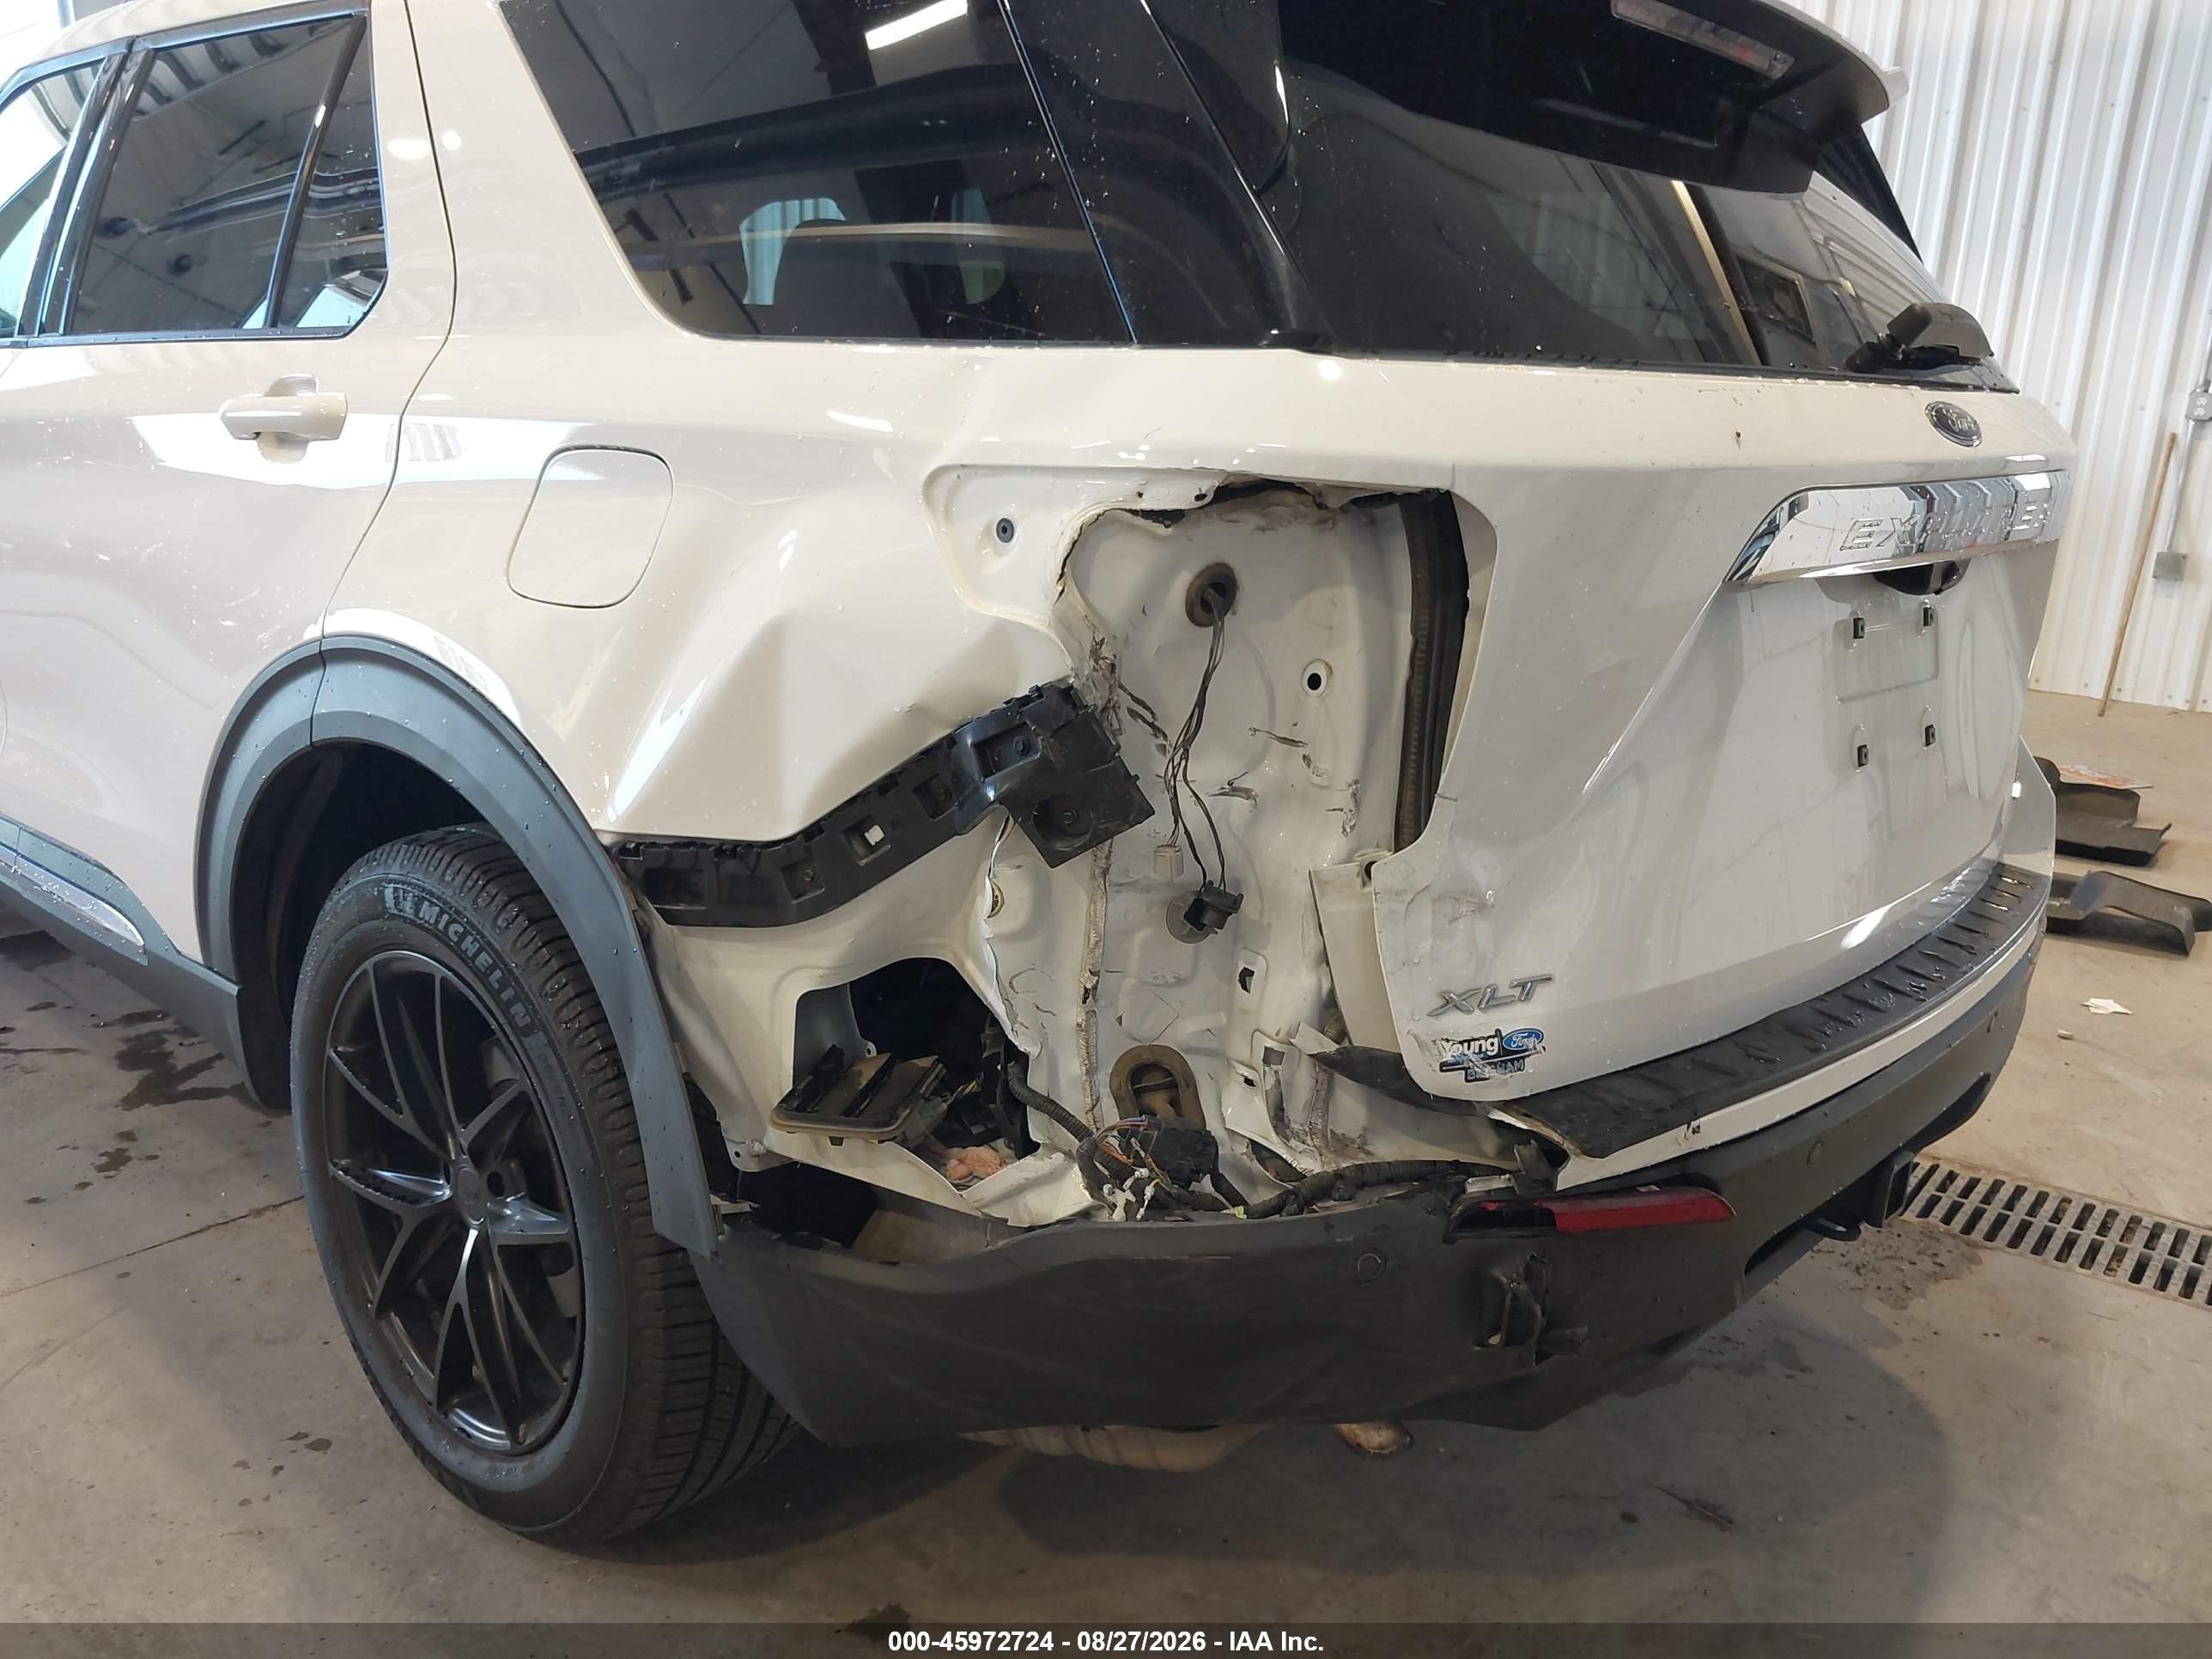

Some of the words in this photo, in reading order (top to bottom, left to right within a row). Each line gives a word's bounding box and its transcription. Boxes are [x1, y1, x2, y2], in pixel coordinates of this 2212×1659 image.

[419, 901, 531, 1028] MICHELIN
[1426, 974, 1553, 1017] XLT
[1442, 1036, 1498, 1059] Young
